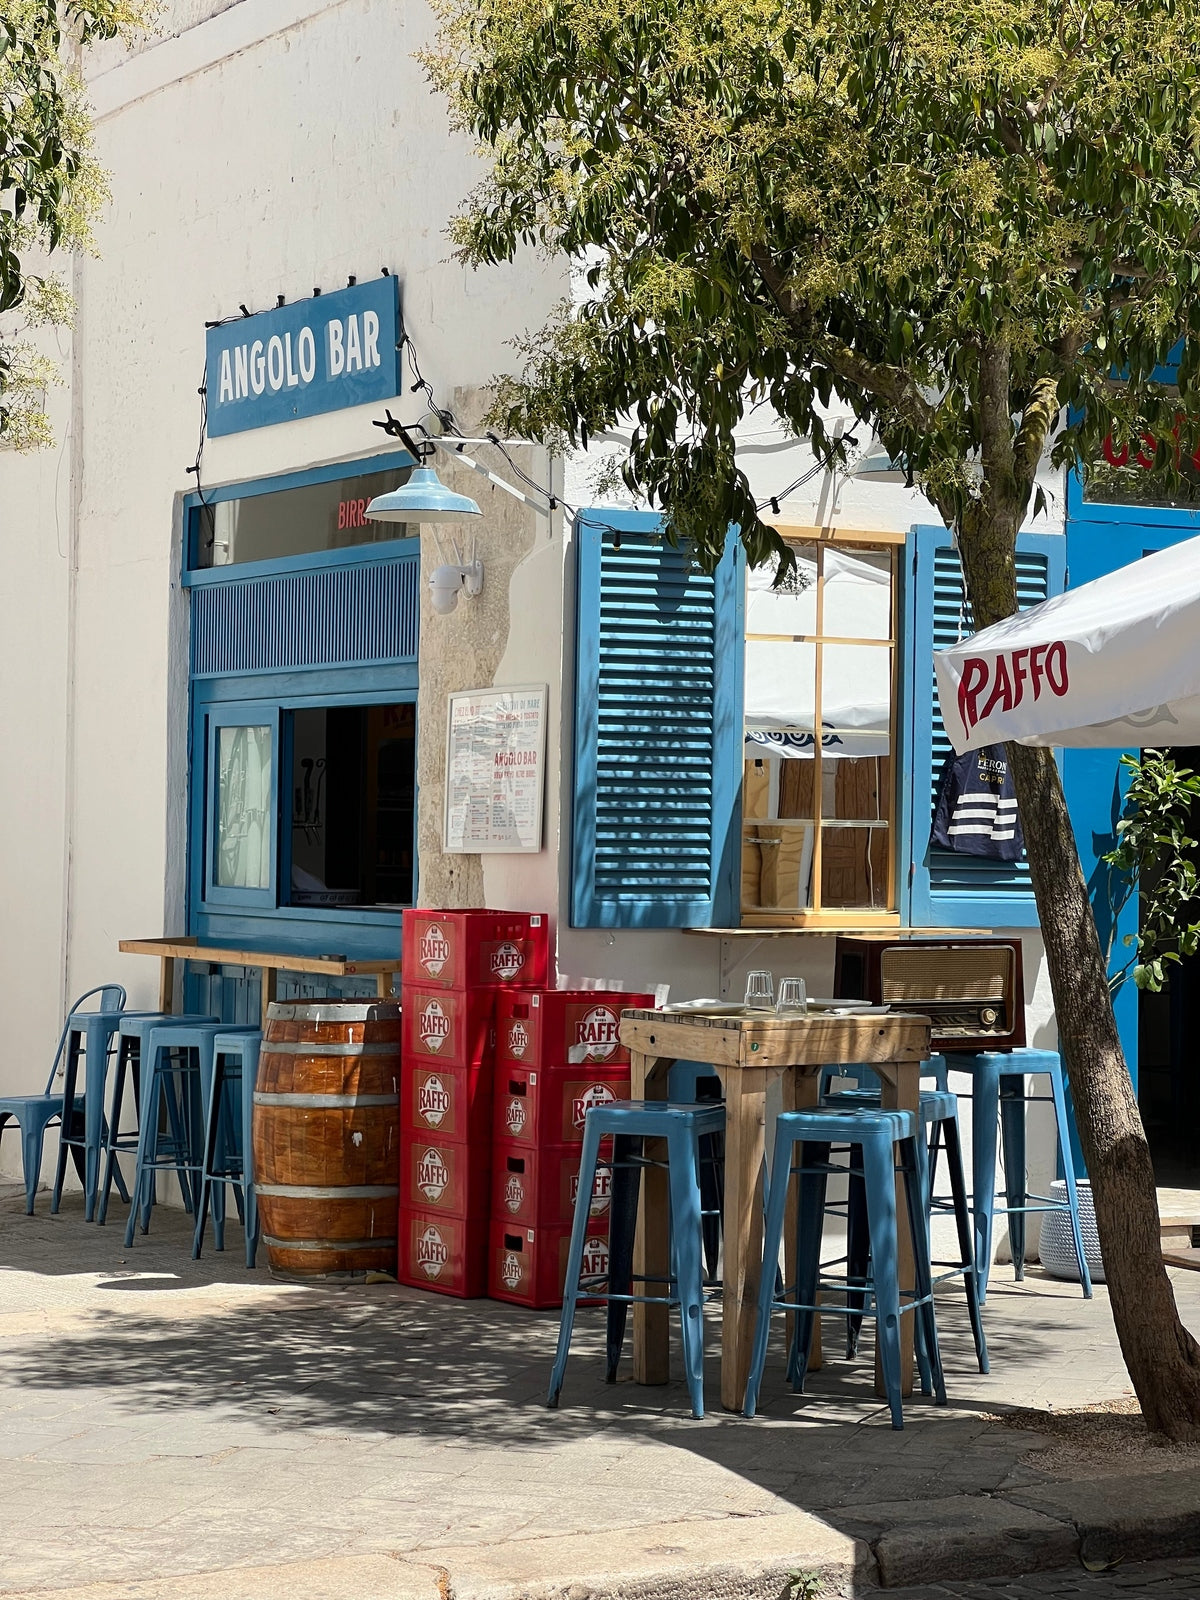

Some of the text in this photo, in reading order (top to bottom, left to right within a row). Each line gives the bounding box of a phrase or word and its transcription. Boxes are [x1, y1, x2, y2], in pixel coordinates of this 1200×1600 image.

[219, 310, 381, 403] ANGOLO BAR
[957, 640, 1069, 741] RAFFO
[494, 750, 537, 767] ANGOLO BAR
[979, 773, 1005, 784] CAPRI
[420, 938, 449, 959] RAFFO
[491, 953, 524, 968] RAFFO
[420, 1013, 449, 1036] RAFFO
[508, 1031, 528, 1046] RAFFO
[419, 1087, 449, 1110] RAFFO
[507, 1107, 526, 1123] RAFFO
[418, 1162, 448, 1186] RAFFO
[504, 1184, 524, 1201] RAFFO
[417, 1238, 448, 1263] RAFFO
[502, 1262, 522, 1278] RAFFO
[582, 1253, 608, 1273] AFF
